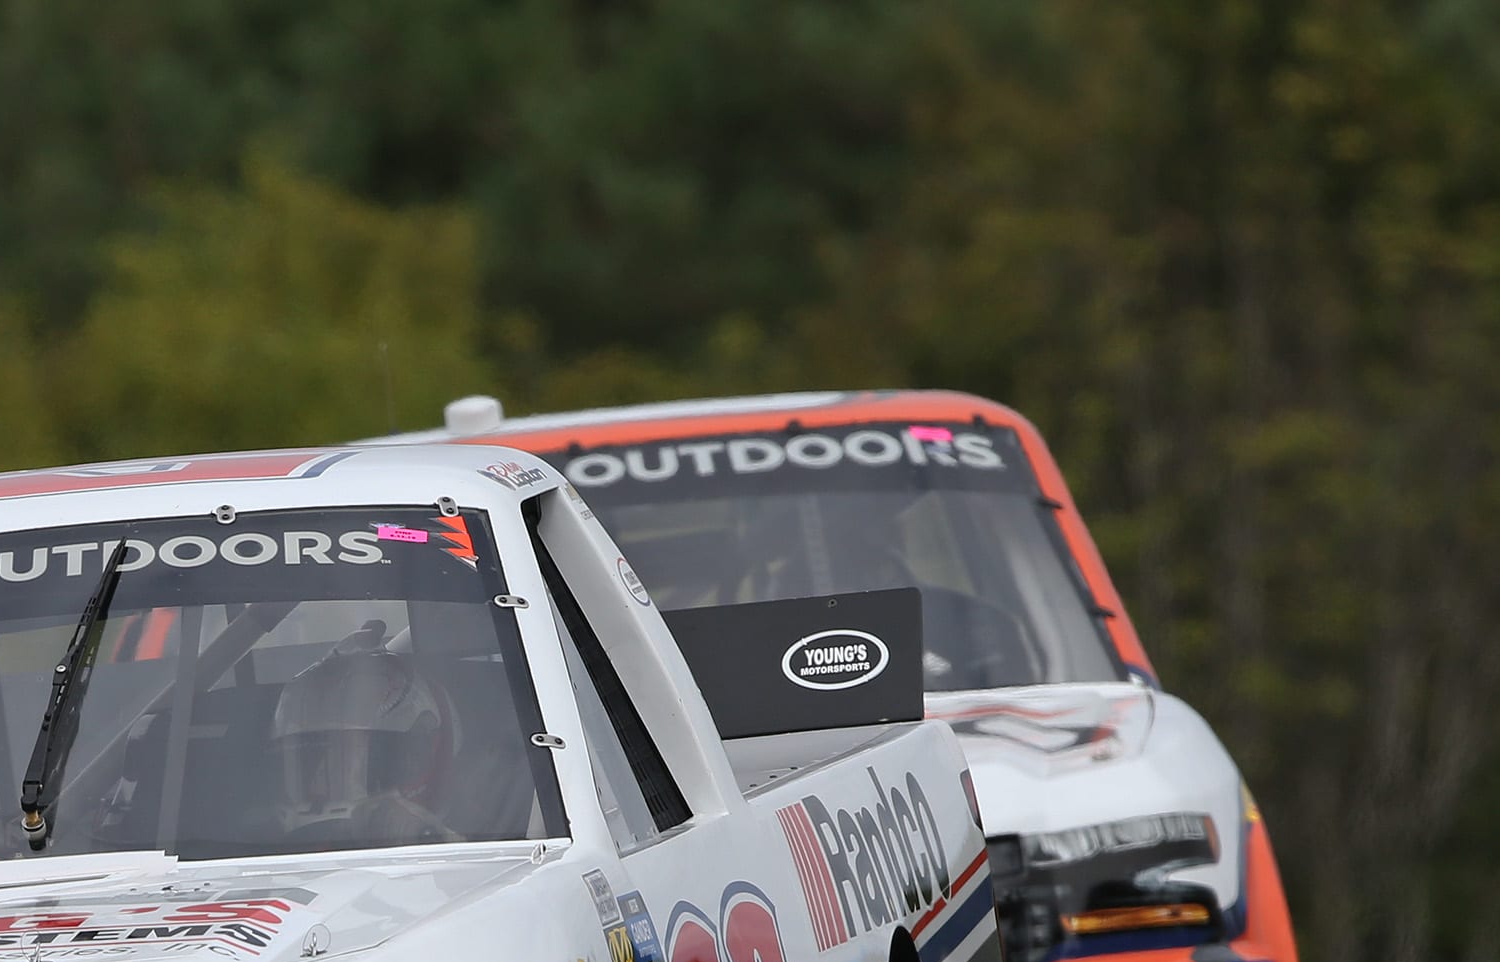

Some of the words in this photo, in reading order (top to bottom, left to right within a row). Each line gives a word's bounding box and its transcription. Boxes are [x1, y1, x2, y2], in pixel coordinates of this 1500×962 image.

[805, 643, 867, 666] YOUNG'S
[800, 662, 870, 676] MOTORSPORTS
[801, 766, 950, 938] Randco
